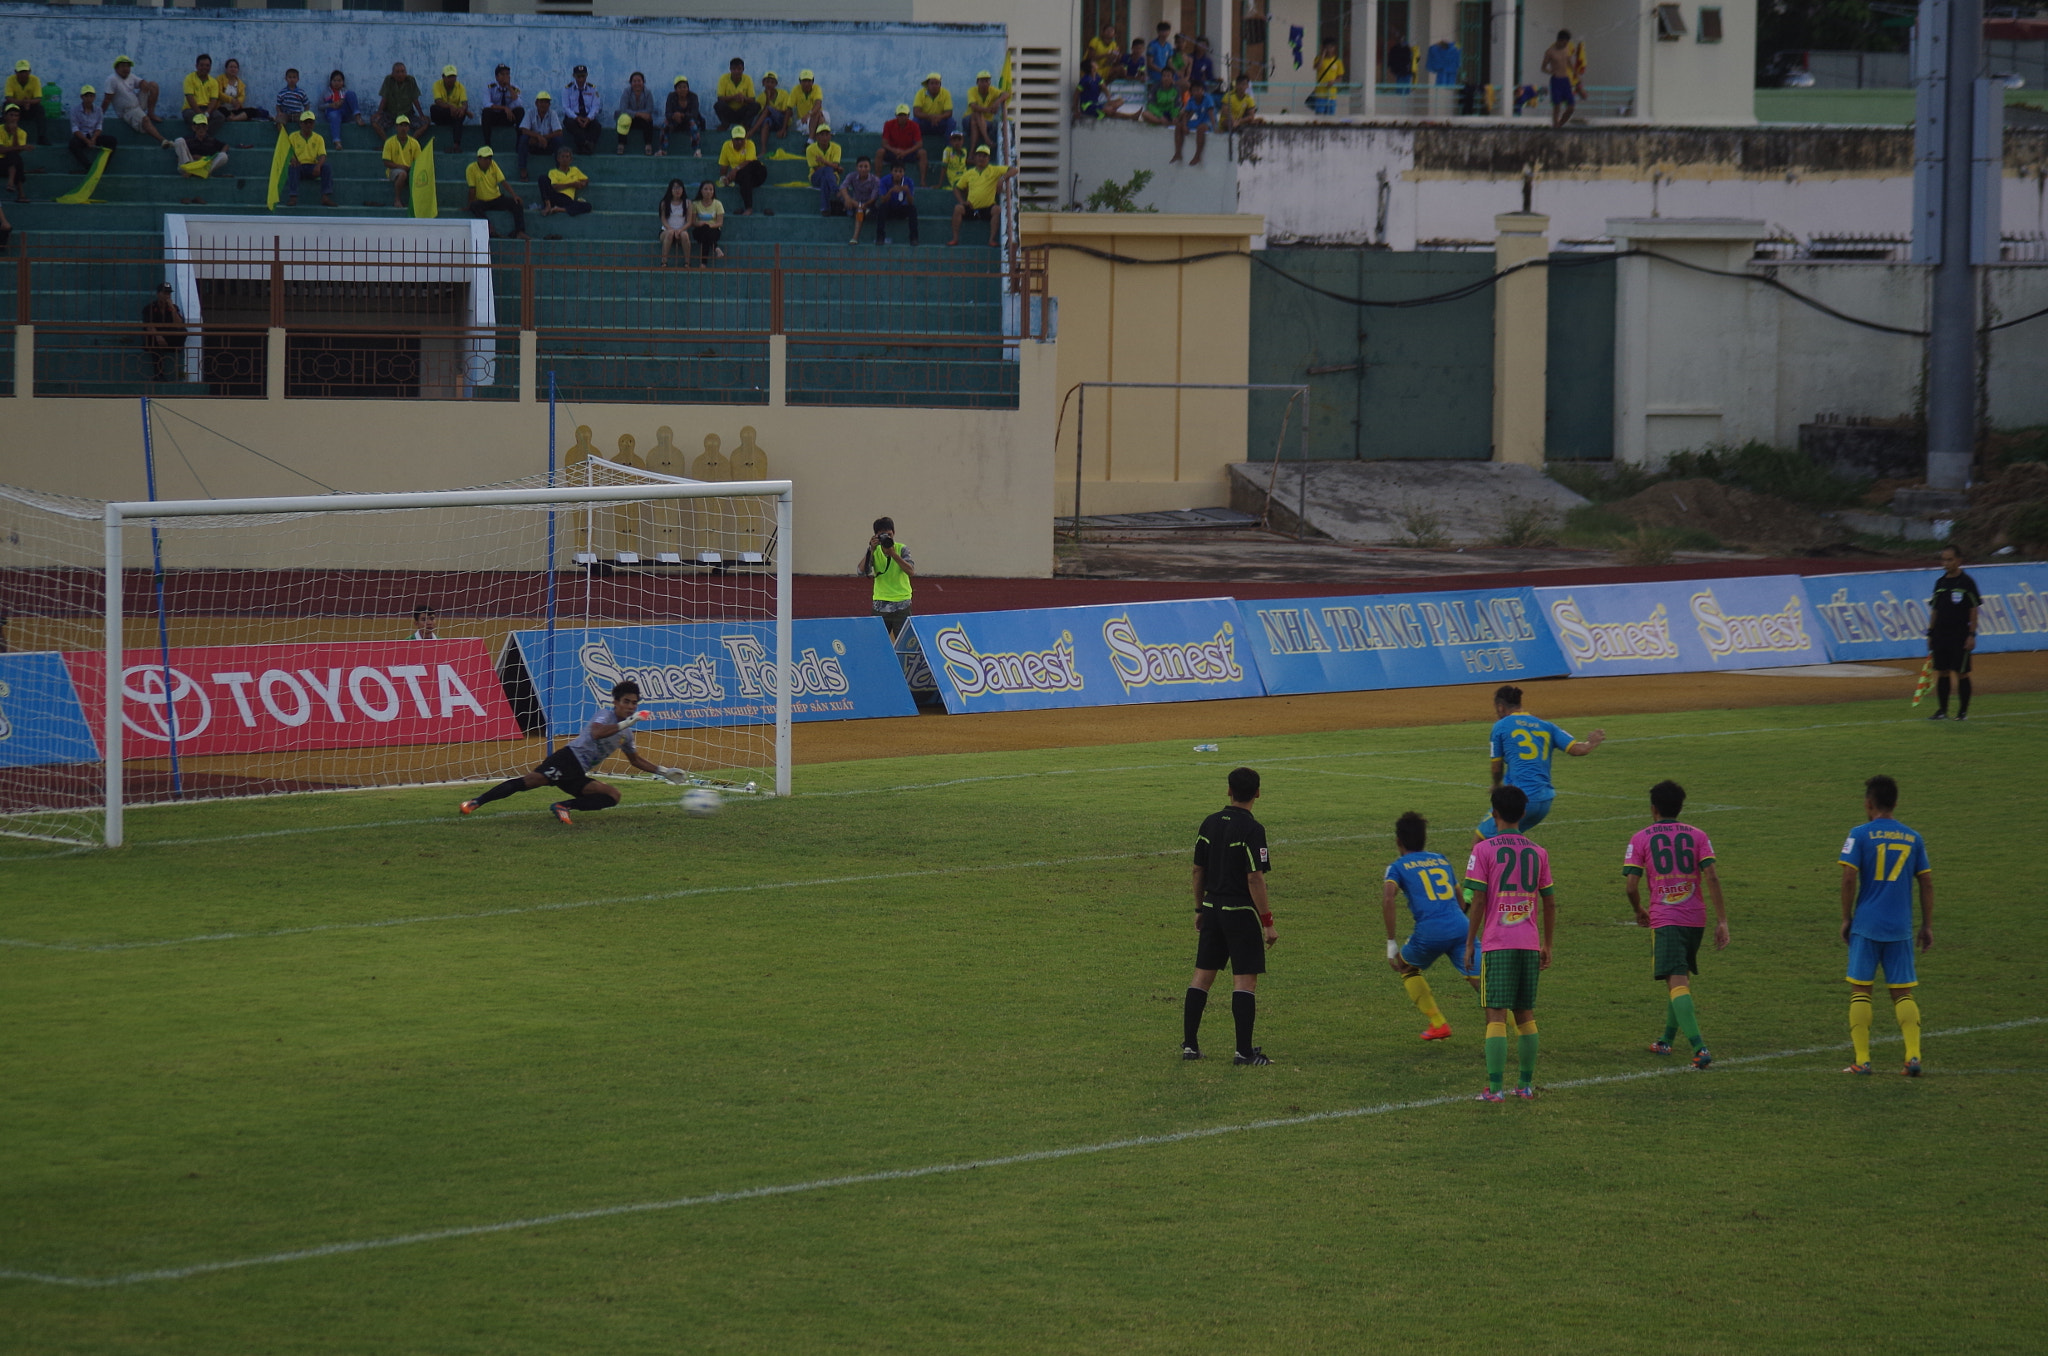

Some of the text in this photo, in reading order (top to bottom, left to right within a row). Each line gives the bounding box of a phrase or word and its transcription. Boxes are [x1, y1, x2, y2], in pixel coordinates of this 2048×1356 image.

[1257, 598, 1536, 654] NHA TRANG PALACE
[1552, 595, 1679, 669] Sanest
[1690, 588, 1812, 662] Sanest
[1816, 588, 1883, 644] YẾN
[579, 637, 726, 709] Sanest
[936, 621, 1084, 706] Sanest
[1103, 612, 1243, 696] Sanest
[1461, 647, 1525, 673] HOTEL
[211, 664, 488, 728] TOYOTA
[1511, 729, 1551, 761] 37
[1497, 846, 1540, 893] 20
[1650, 832, 1695, 875] 66
[1874, 843, 1912, 882] 17
[1418, 867, 1455, 901] 13
[1498, 902, 1531, 913] Ranee
